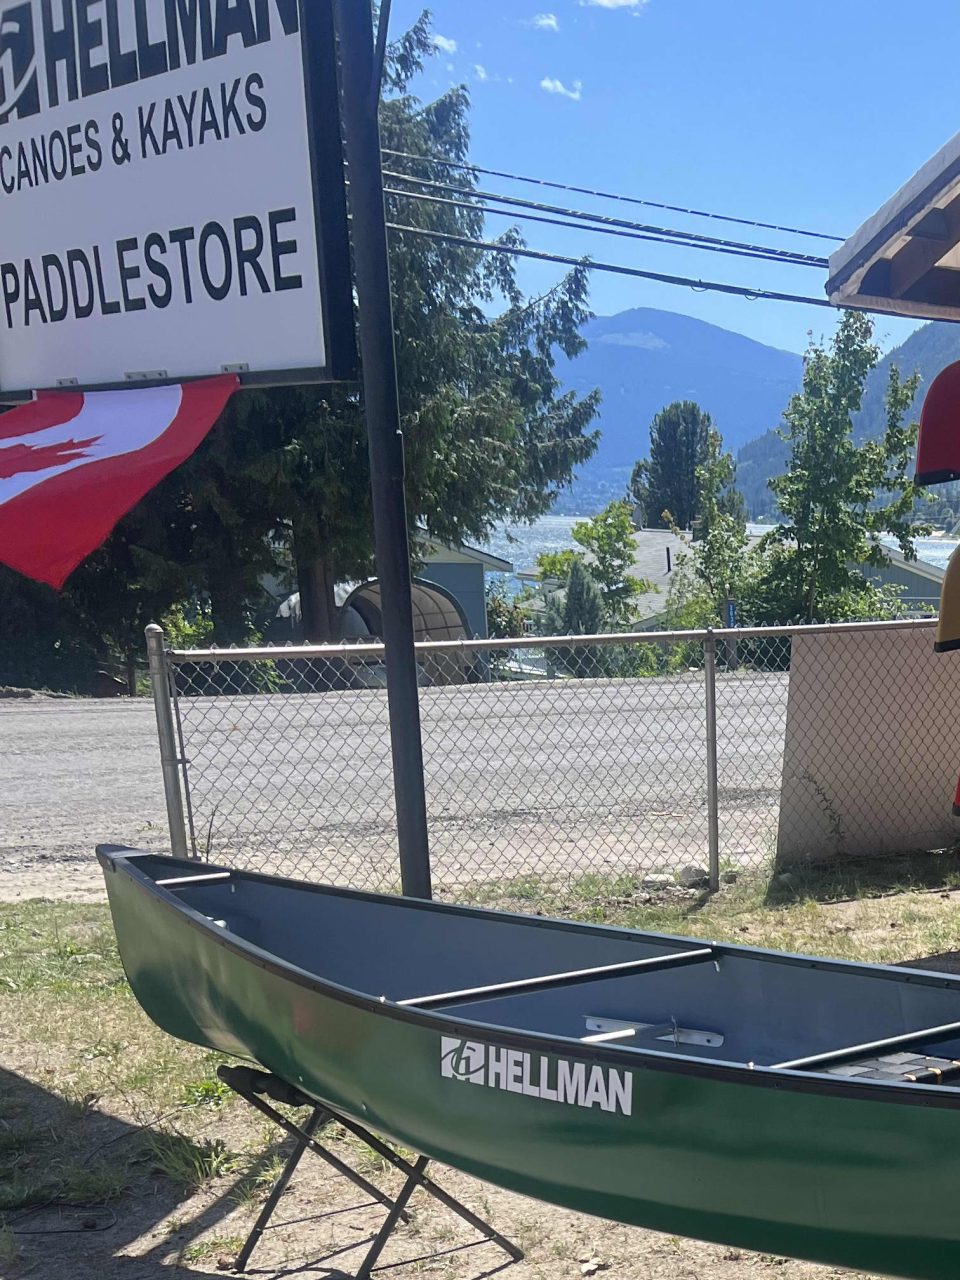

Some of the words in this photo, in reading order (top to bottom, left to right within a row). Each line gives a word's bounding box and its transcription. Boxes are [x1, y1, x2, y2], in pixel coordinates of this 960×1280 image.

[0, 119, 103, 194] CANOES
[111, 112, 131, 165] &
[138, 72, 267, 159] KAYAKS
[1, 206, 303, 329] PADDLESTORE
[488, 1045, 633, 1116] HELLMAN
